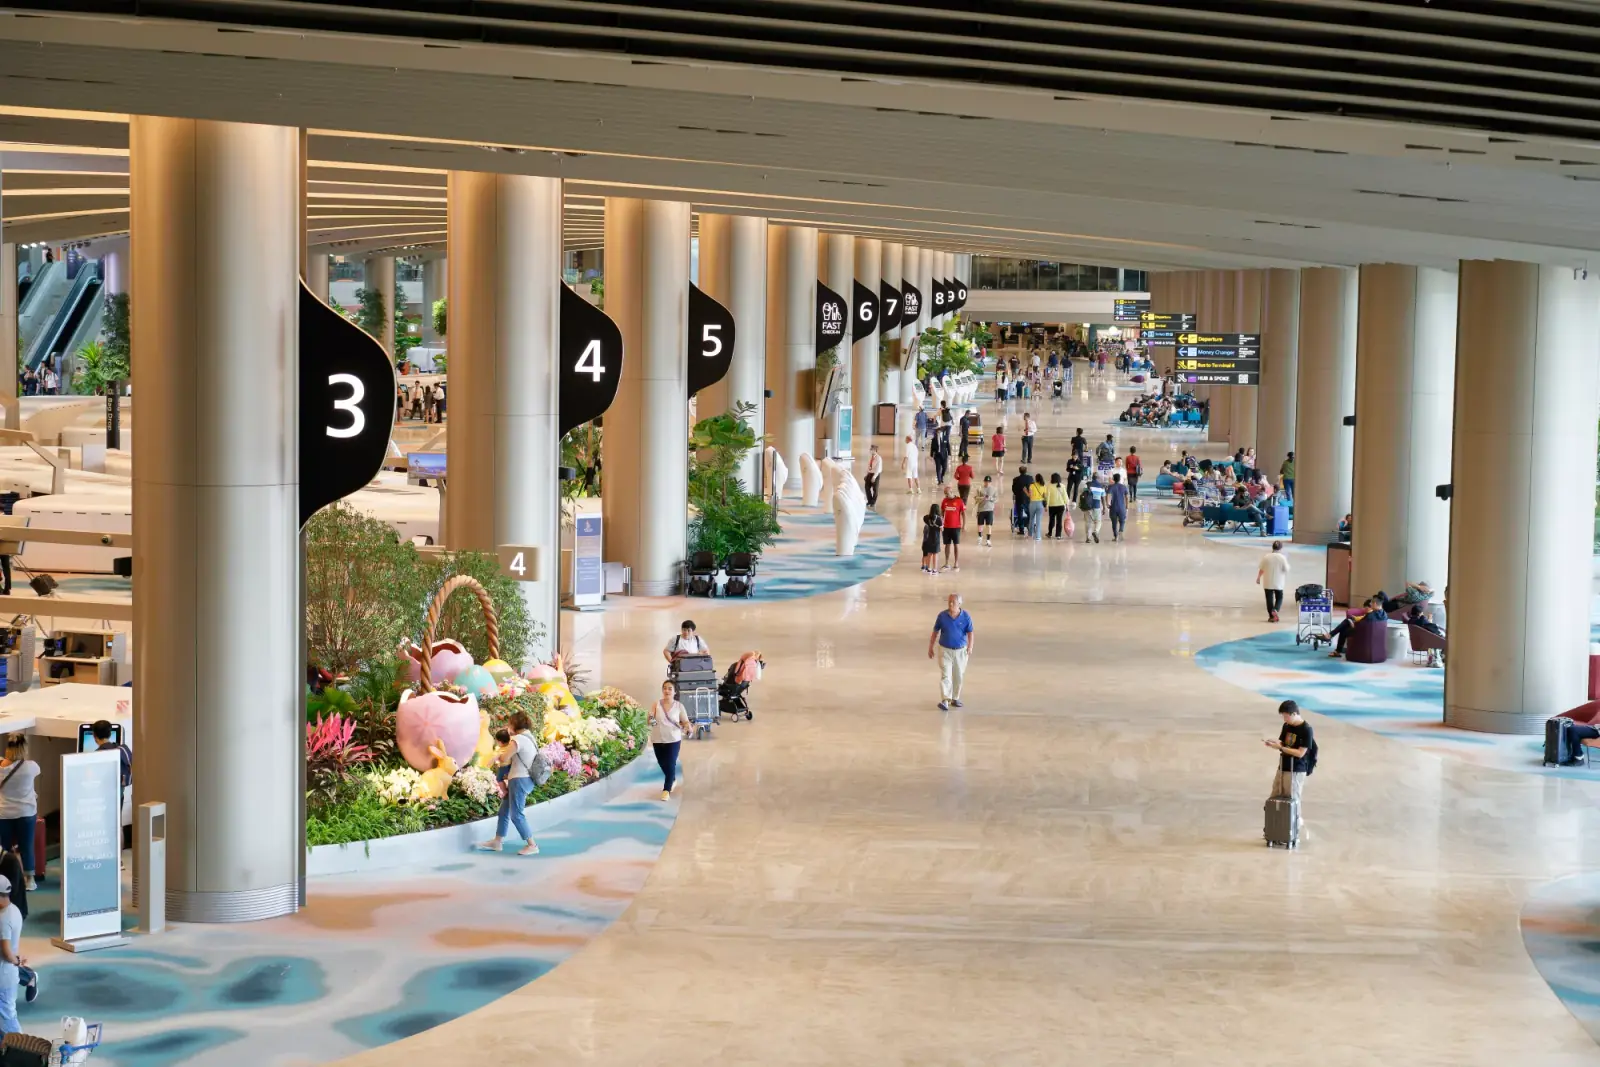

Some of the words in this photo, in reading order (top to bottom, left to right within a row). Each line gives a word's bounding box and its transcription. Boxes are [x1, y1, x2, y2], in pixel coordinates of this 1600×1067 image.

[886, 299, 898, 316] 7
[935, 292, 945, 305] 8
[859, 302, 873, 321] 6
[702, 324, 723, 357] 5
[574, 339, 606, 383] 4
[326, 373, 366, 439] 3
[509, 551, 527, 576] 4
